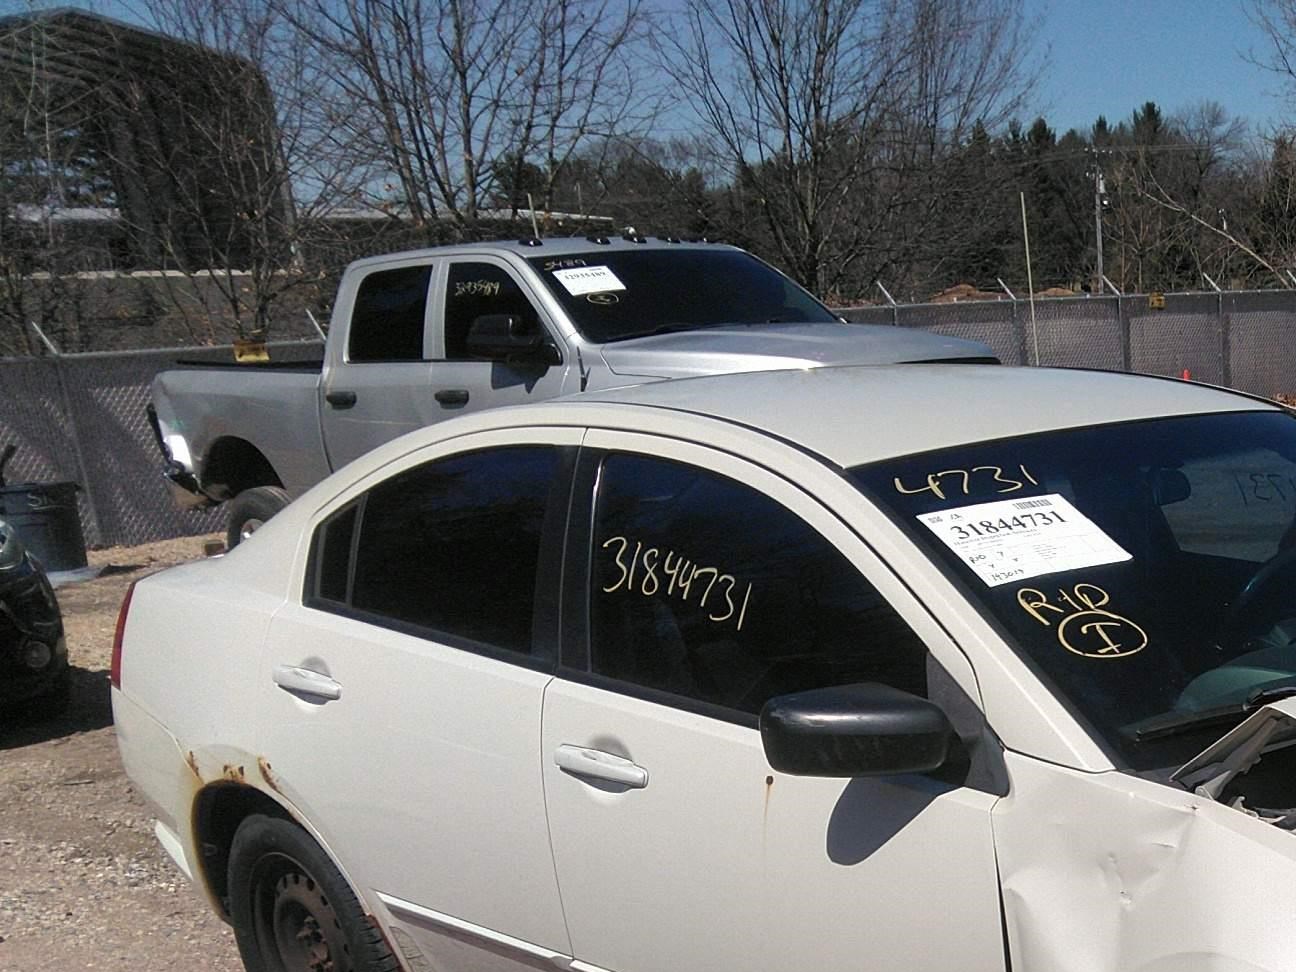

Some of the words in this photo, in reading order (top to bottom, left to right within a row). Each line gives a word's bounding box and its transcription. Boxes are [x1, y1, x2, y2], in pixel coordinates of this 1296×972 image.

[894, 464, 1038, 500] 4731
[950, 510, 1068, 541] 31844731
[602, 536, 752, 631] 31844731
